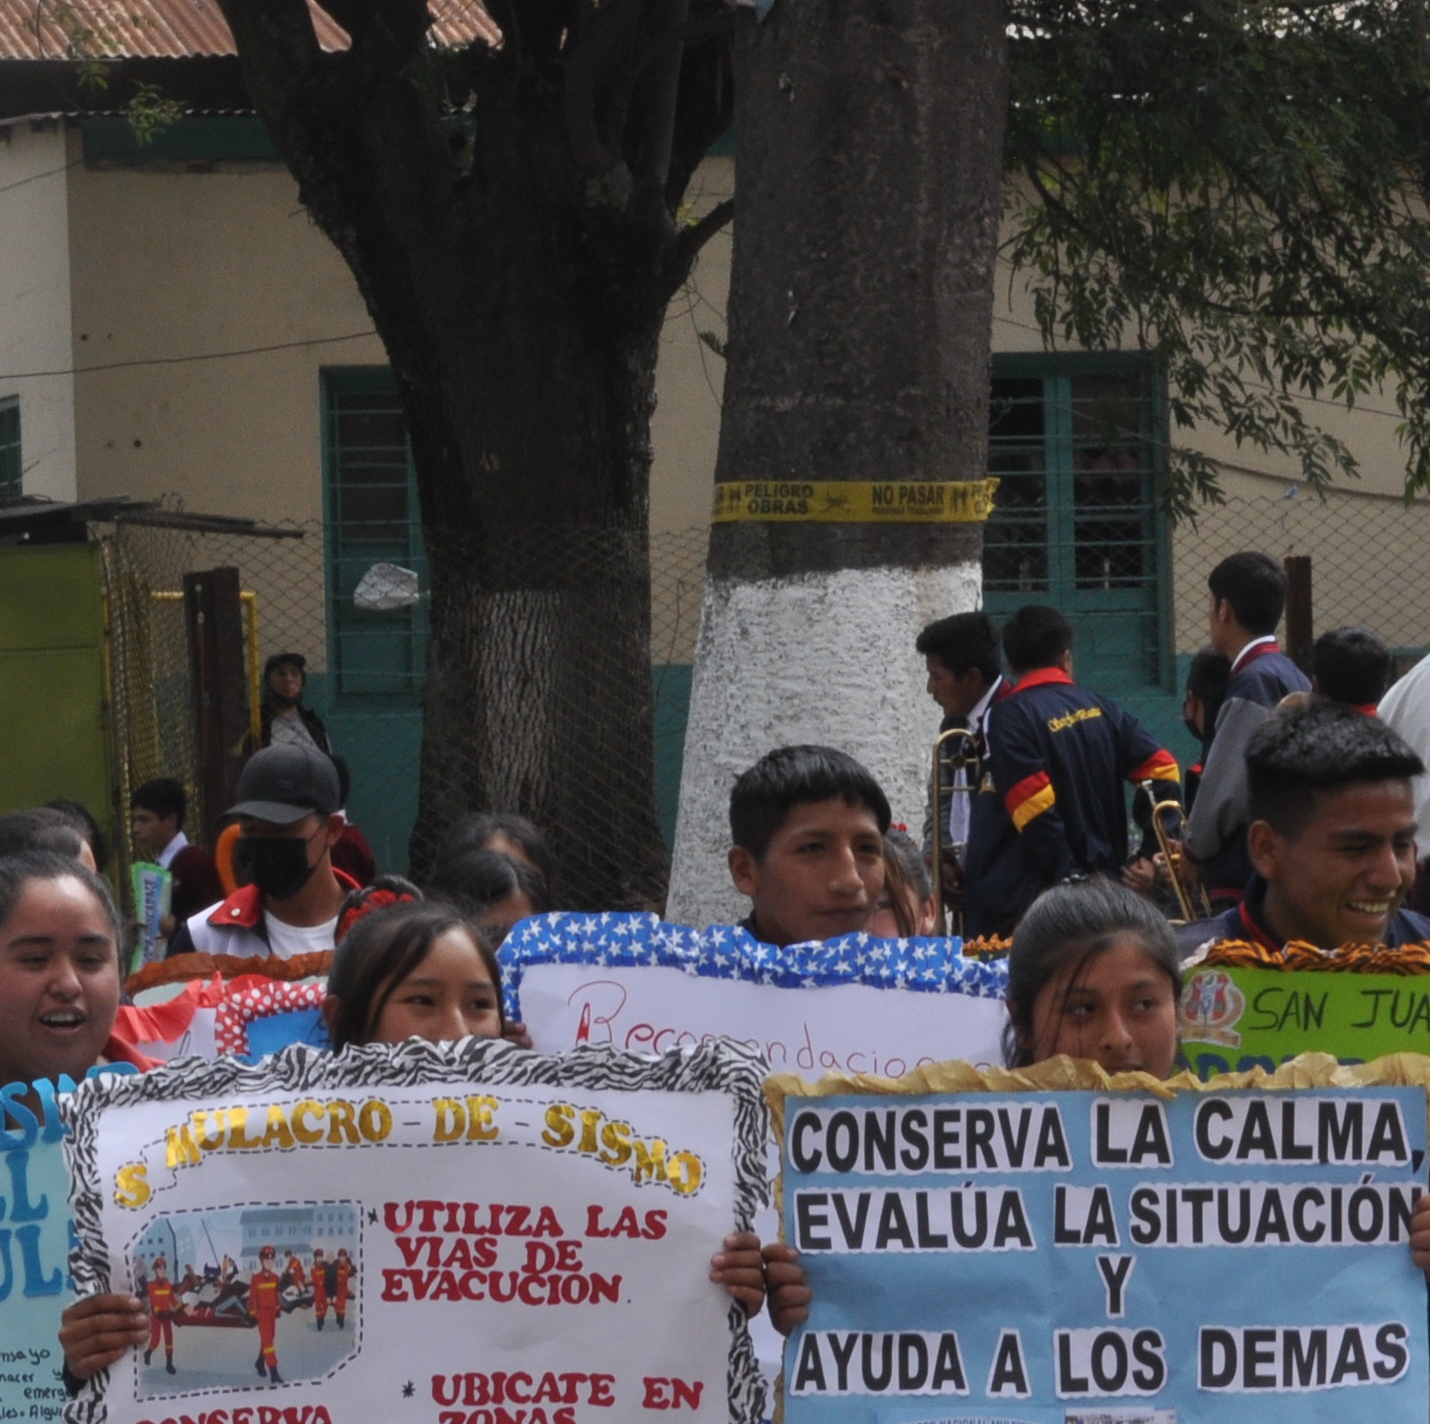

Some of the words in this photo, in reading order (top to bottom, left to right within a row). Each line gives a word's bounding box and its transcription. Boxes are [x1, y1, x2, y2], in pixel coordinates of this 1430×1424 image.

[745, 484, 814, 499] PELIGRO
[748, 500, 808, 514] OBRAS
[873, 486, 894, 505] NO
[899, 486, 944, 505] PASAR
[1248, 986, 1329, 1032] SAN
[433, 1095, 499, 1142] DE
[541, 1104, 702, 1194] SISMO
[792, 1104, 1070, 1173] CONSERVA
[1095, 1100, 1171, 1165] LA
[383, 1199, 564, 1238] UTILIZA
[584, 1204, 668, 1241] LAS
[796, 1182, 1034, 1251] EVALÚA
[1054, 1186, 1118, 1246] LA
[1131, 1174, 1423, 1244] SITUACIÓN
[394, 1236, 498, 1270] VIAS
[520, 1240, 583, 1275] DE
[1097, 1255, 1132, 1315] Y
[794, 1333, 967, 1392] AYUDA
[990, 1332, 1028, 1394] A
[1058, 1328, 1165, 1394] LOS
[1200, 1323, 1408, 1389] DEMAS
[431, 1371, 616, 1407] UBICATE
[642, 1377, 704, 1410] EN
